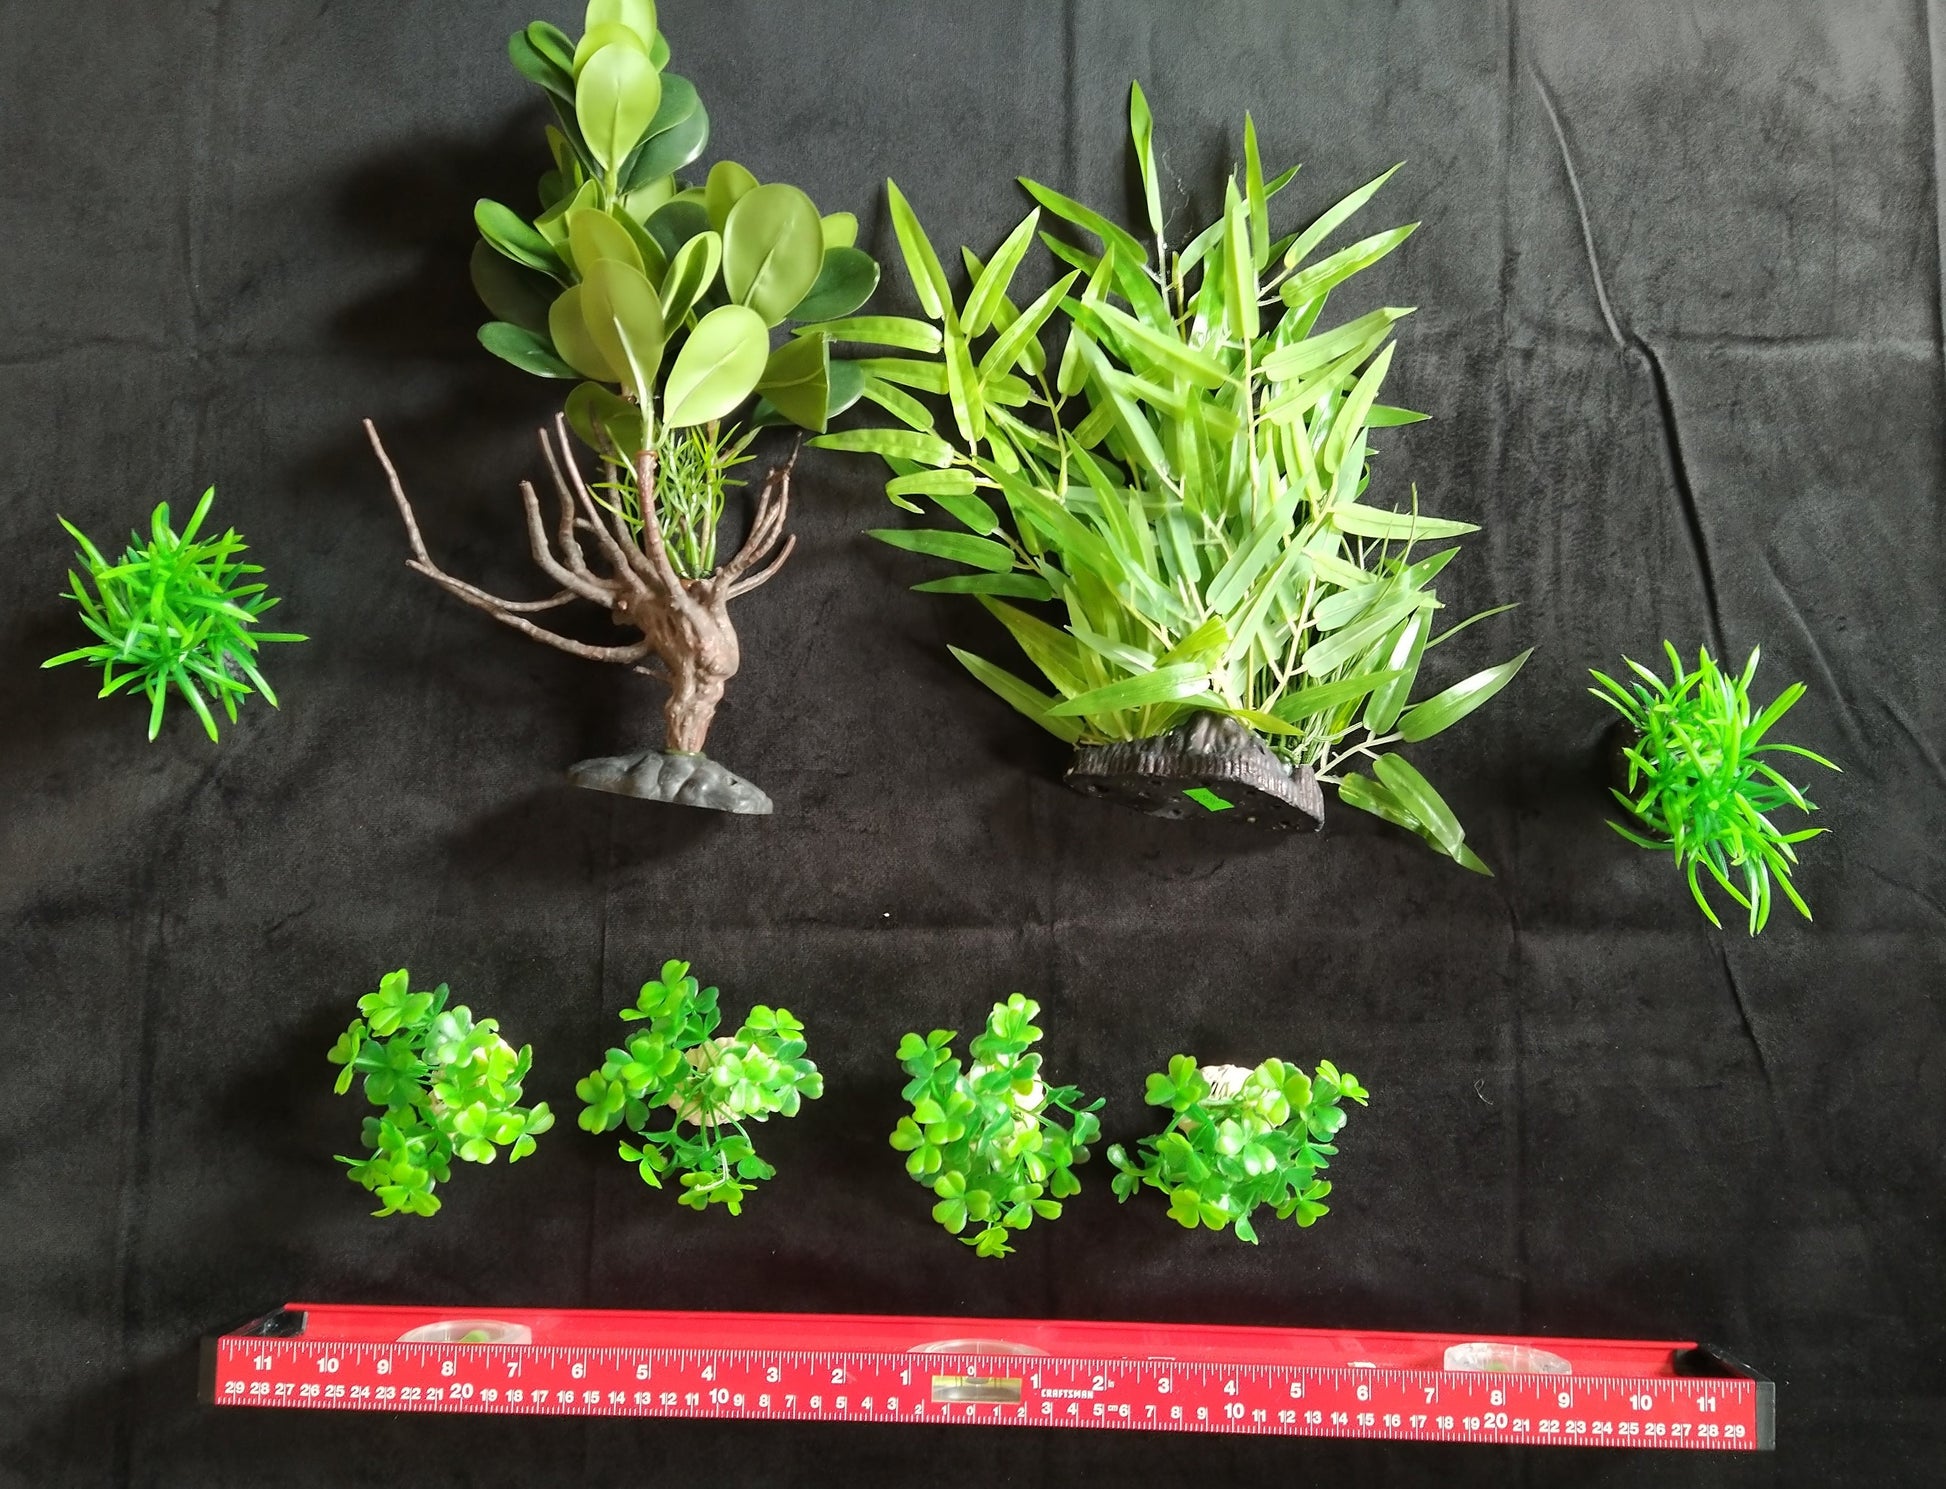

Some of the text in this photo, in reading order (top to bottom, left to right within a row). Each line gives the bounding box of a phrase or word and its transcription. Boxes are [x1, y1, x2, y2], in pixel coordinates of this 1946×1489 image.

[225, 1382, 245, 1394] 29
[250, 1383, 270, 1395] 28
[275, 1384, 295, 1395] 27
[300, 1385, 320, 1396] 26
[325, 1386, 345, 1397] 25
[350, 1386, 370, 1398] 24
[375, 1387, 395, 1399] 23
[400, 1388, 421, 1399] 22
[426, 1388, 443, 1400] 21
[450, 1383, 473, 1398] 20
[480, 1389, 498, 1401] 19
[506, 1390, 523, 1402] 18
[531, 1391, 549, 1402] 17
[557, 1391, 574, 1403] 16
[583, 1391, 600, 1403] 15
[608, 1392, 625, 1404] 14
[634, 1392, 651, 1404] 13
[659, 1393, 677, 1405] 12
[685, 1394, 699, 1406] 11
[709, 1389, 729, 1404] 10
[734, 1395, 742, 1406] 9
[759, 1395, 768, 1407] 8
[785, 1396, 794, 1408] 7
[810, 1396, 820, 1408] 6
[836, 1397, 845, 1409] 5
[861, 1397, 871, 1409] 4
[887, 1398, 897, 1410] 3
[915, 1405, 922, 1414] 2
[941, 1406, 947, 1415] 1
[966, 1406, 974, 1416] 0
[993, 1407, 999, 1416] 1
[1018, 1408, 1025, 1417] 2
[1041, 1402, 1051, 1414] 3
[1067, 1403, 1076, 1415] 4
[1093, 1403, 1102, 1415] 5
[1119, 1404, 1128, 1416] 6
[1145, 1405, 1154, 1417] 7
[1171, 1406, 1180, 1418] 8
[1197, 1407, 1206, 1420] 9
[1224, 1403, 1244, 1419] 10
[1252, 1410, 1266, 1422] 11
[1278, 1411, 1295, 1423] 12
[1304, 1411, 1322, 1424] 13
[1330, 1412, 1348, 1425] 14
[1357, 1413, 1375, 1426] 15
[1383, 1414, 1401, 1427] 16
[1410, 1416, 1427, 1428] 17
[1436, 1417, 1454, 1429] 18
[1463, 1418, 1480, 1430] 19
[1484, 1413, 1508, 1428] 20
[1513, 1419, 1530, 1432] 21
[1539, 1420, 1560, 1433] 22
[1565, 1421, 1586, 1434] 23
[1592, 1422, 1612, 1435] 24
[1619, 1423, 1639, 1435] 25
[1645, 1424, 1666, 1436] 26
[1671, 1424, 1691, 1436] 27
[1698, 1425, 1719, 1437] 28
[1725, 1425, 1745, 1437] 29
[254, 1357, 272, 1370] 11
[317, 1358, 339, 1372] 10
[377, 1360, 389, 1374] 9
[441, 1361, 453, 1376] 8
[507, 1363, 518, 1377] 7
[571, 1364, 583, 1378] 6
[636, 1365, 648, 1380] 5
[701, 1366, 713, 1381] 4
[767, 1367, 779, 1382] 3
[831, 1369, 843, 1383] 2
[900, 1370, 909, 1384] 1
[967, 1366, 975, 1375] 0
[1031, 1374, 1039, 1388] 1
[1093, 1376, 1104, 1390] 2
[1158, 1378, 1169, 1393] 3
[1224, 1380, 1236, 1395] 4
[1290, 1383, 1302, 1398] 5
[1357, 1385, 1368, 1400] 6
[1424, 1388, 1435, 1403] 7
[1491, 1390, 1503, 1405] 8
[1558, 1393, 1570, 1408] 9
[1630, 1395, 1652, 1410] 10
[1697, 1397, 1716, 1412] 11
[1041, 1389, 1093, 1399] CRAFTSMAN
